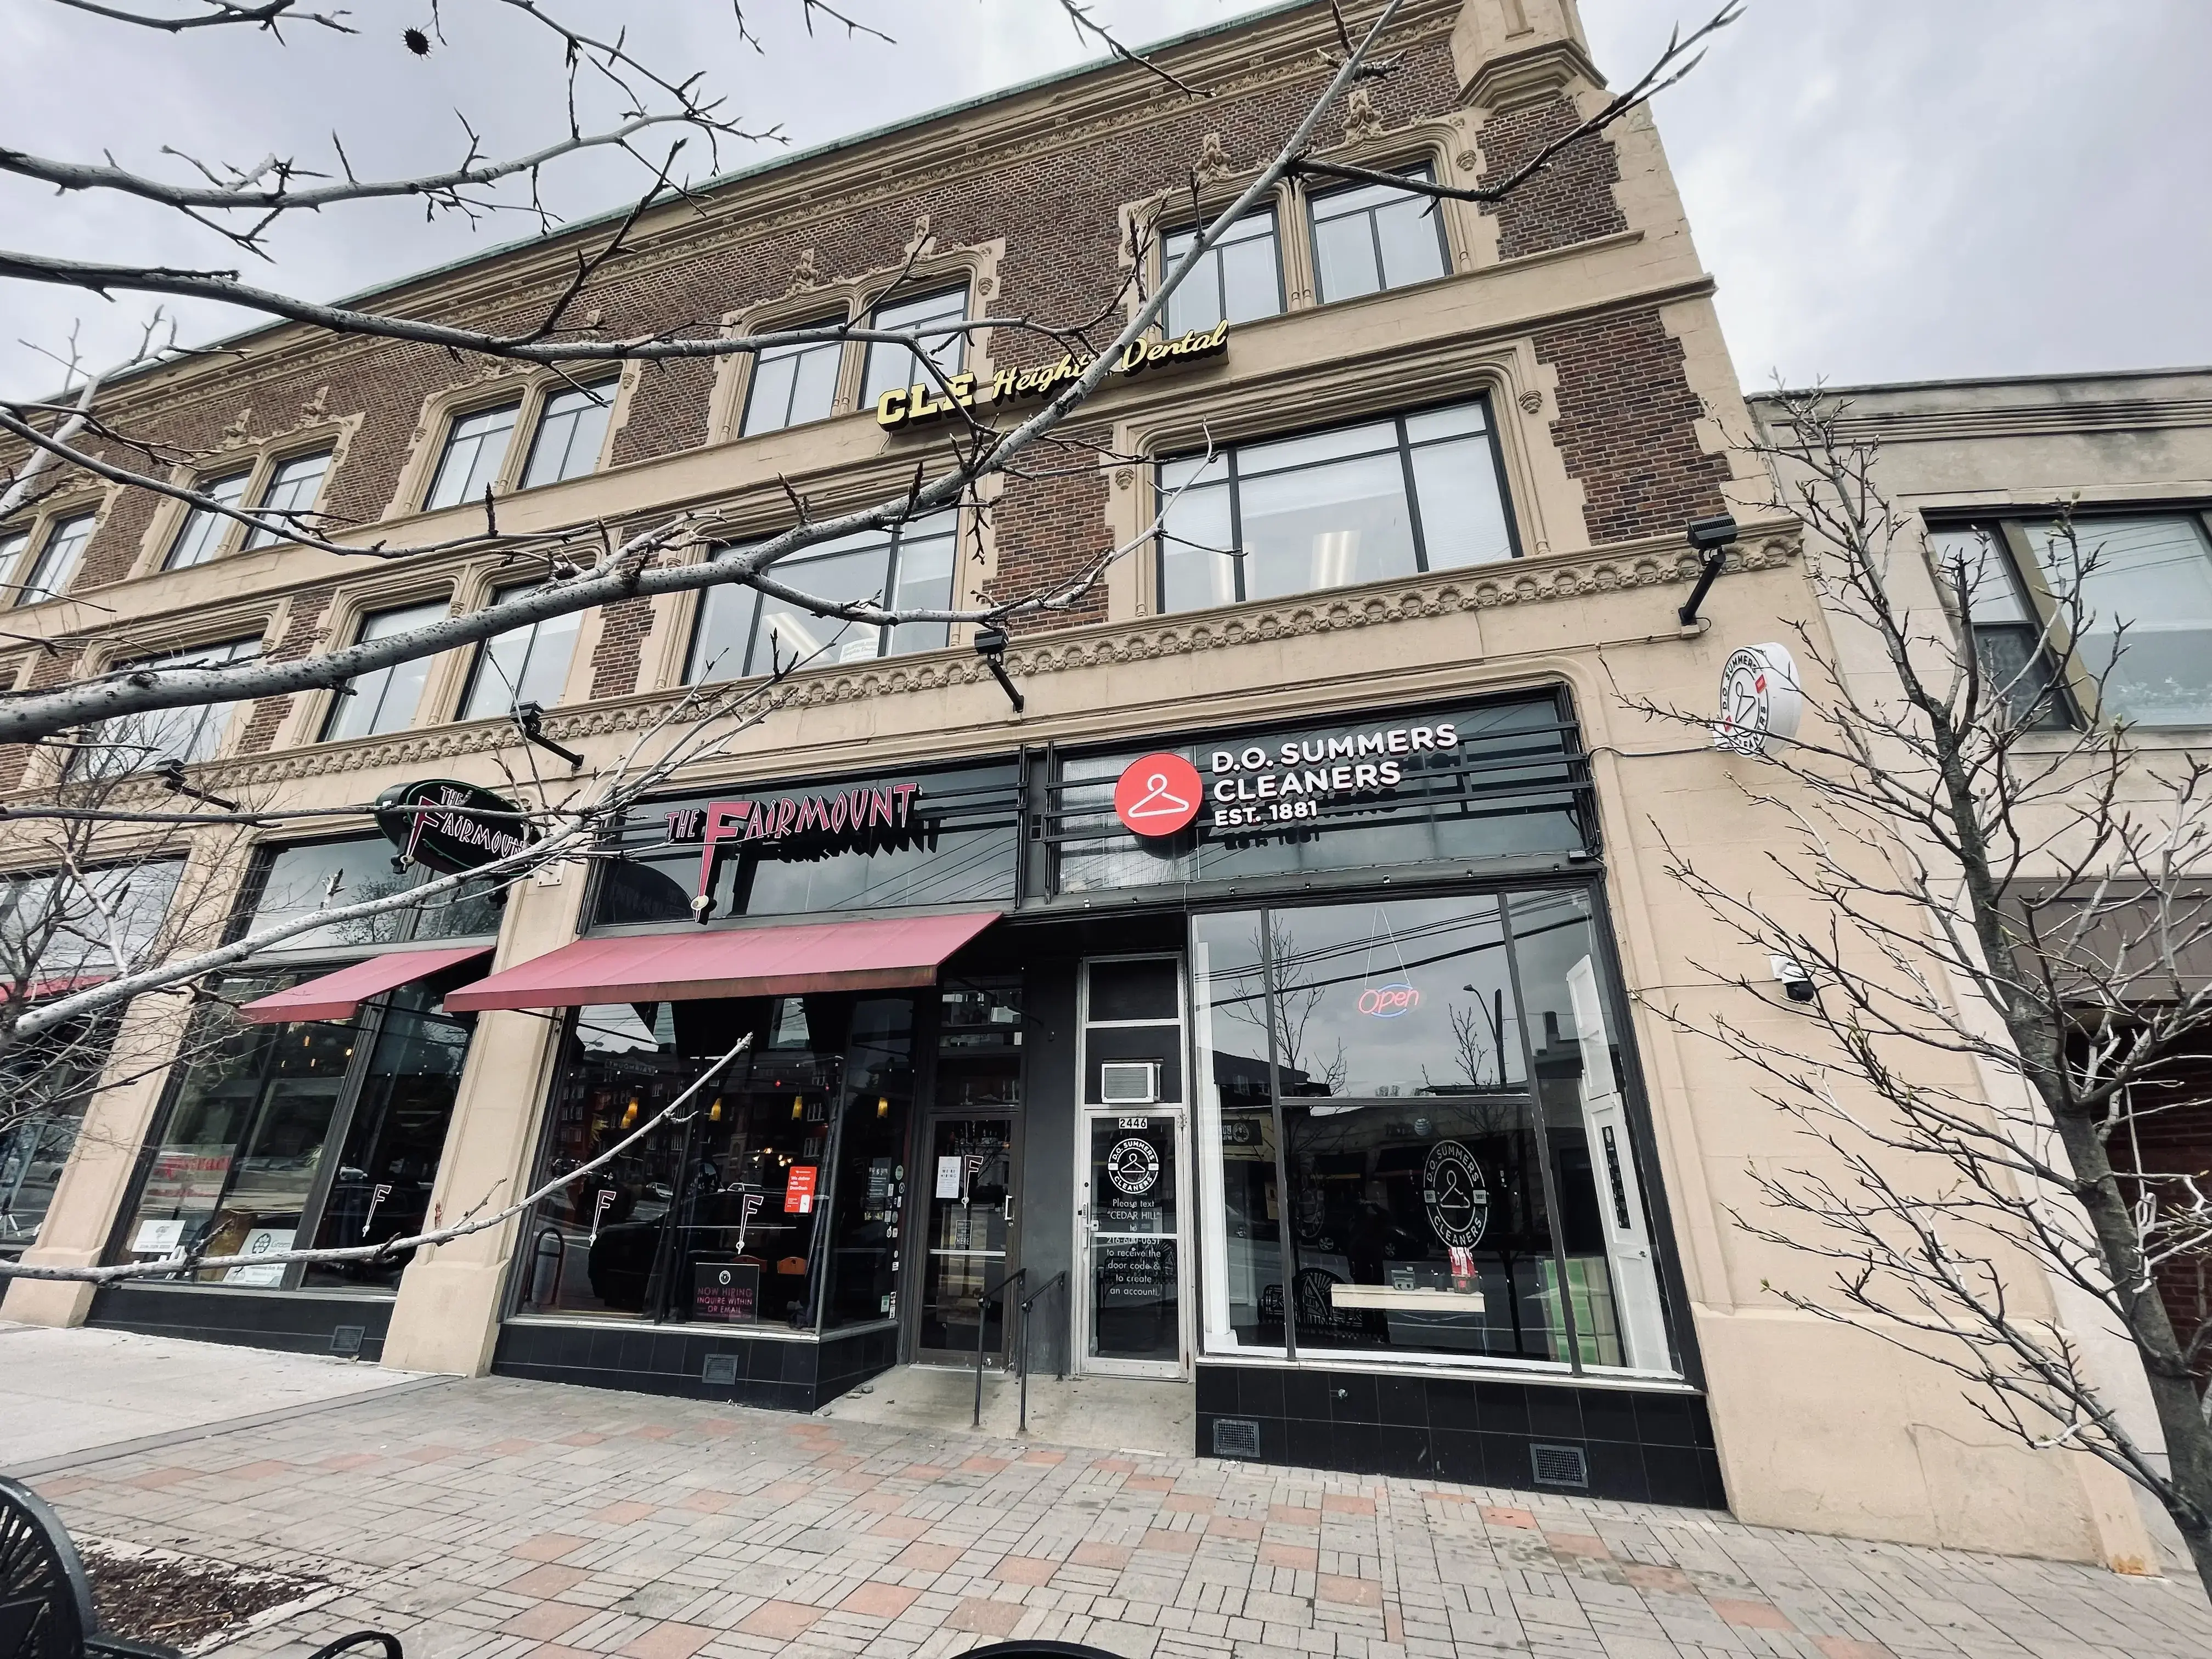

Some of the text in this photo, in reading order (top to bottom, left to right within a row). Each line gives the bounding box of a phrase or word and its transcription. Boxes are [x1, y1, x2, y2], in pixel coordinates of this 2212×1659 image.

[877, 318, 1229, 427] CLE Height Dental
[1725, 655, 1757, 681] SUMMERS
[1211, 723, 1458, 774] D.O. SUMMERS
[1212, 761, 1402, 803] CLEANERS
[441, 786, 464, 806] THE
[1214, 799, 1318, 827] EST. 1881
[399, 795, 524, 871] FAIRMOUN
[664, 808, 699, 838] THE
[690, 782, 920, 923] FAIRMOUNT
[1358, 989, 1419, 1014] Open
[1120, 1119, 1147, 1128] 2446
[1112, 1141, 1155, 1160] D.O. SUMMERS
[1426, 1146, 1479, 1182] D.O. SUMMERS
[1114, 1176, 1153, 1191] CLEANERS
[1113, 1198, 1137, 1207] Please
[1434, 1216, 1482, 1245] CLEANERS
[1118, 1249, 1146, 1257] receive
[1149, 1248, 1161, 1257] the
[1108, 1259, 1161, 1270] door code &
[1116, 1273, 1124, 1282] to
[697, 1286, 753, 1297] NOW HIRING
[697, 1296, 726, 1305] INQUIRE
[720, 1306, 741, 1314] EMAIL
